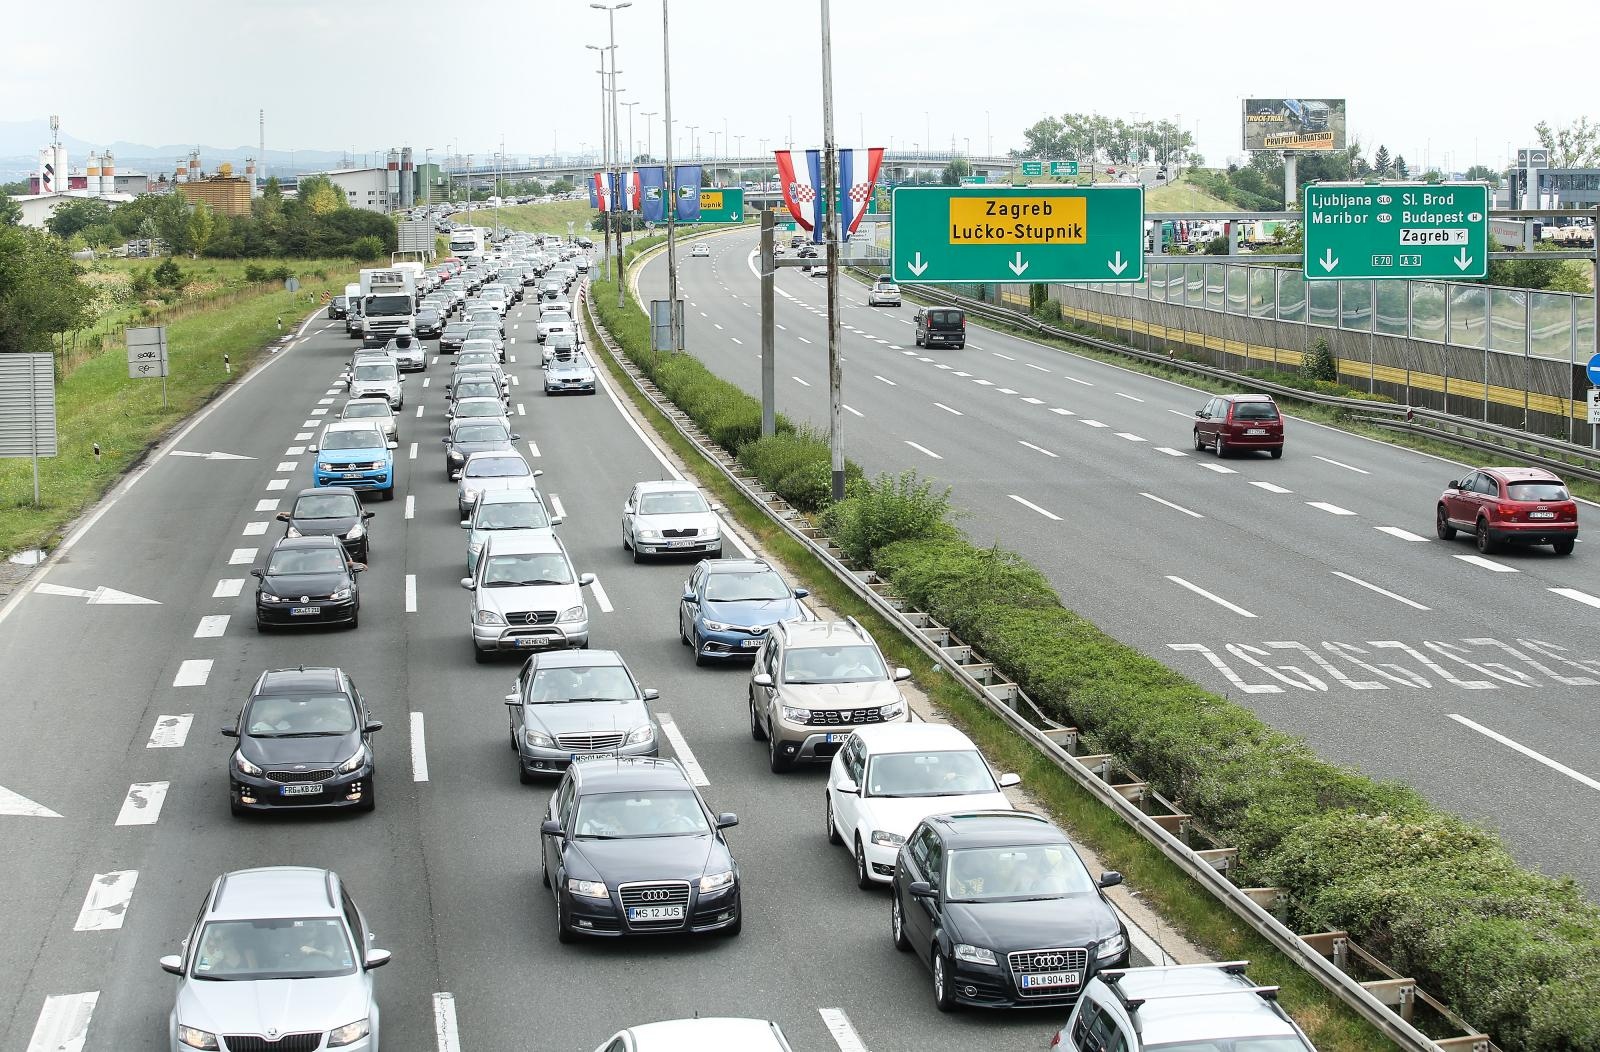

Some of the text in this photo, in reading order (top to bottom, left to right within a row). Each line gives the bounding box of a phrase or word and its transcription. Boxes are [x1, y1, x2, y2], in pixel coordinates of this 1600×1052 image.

[1312, 193, 1391, 208] Ljubljana SLO
[1402, 193, 1454, 205] Sl. Brod
[986, 200, 1053, 219] Zagreb
[1312, 211, 1391, 224] Maribor SLO
[1402, 211, 1464, 225] Budapest
[953, 223, 1083, 242] Lučko-Stupnik
[1402, 229, 1449, 244] Zagreb
[635, 907, 680, 918] MS 12 JUS
[1030, 974, 1076, 986] BL 904 BD
